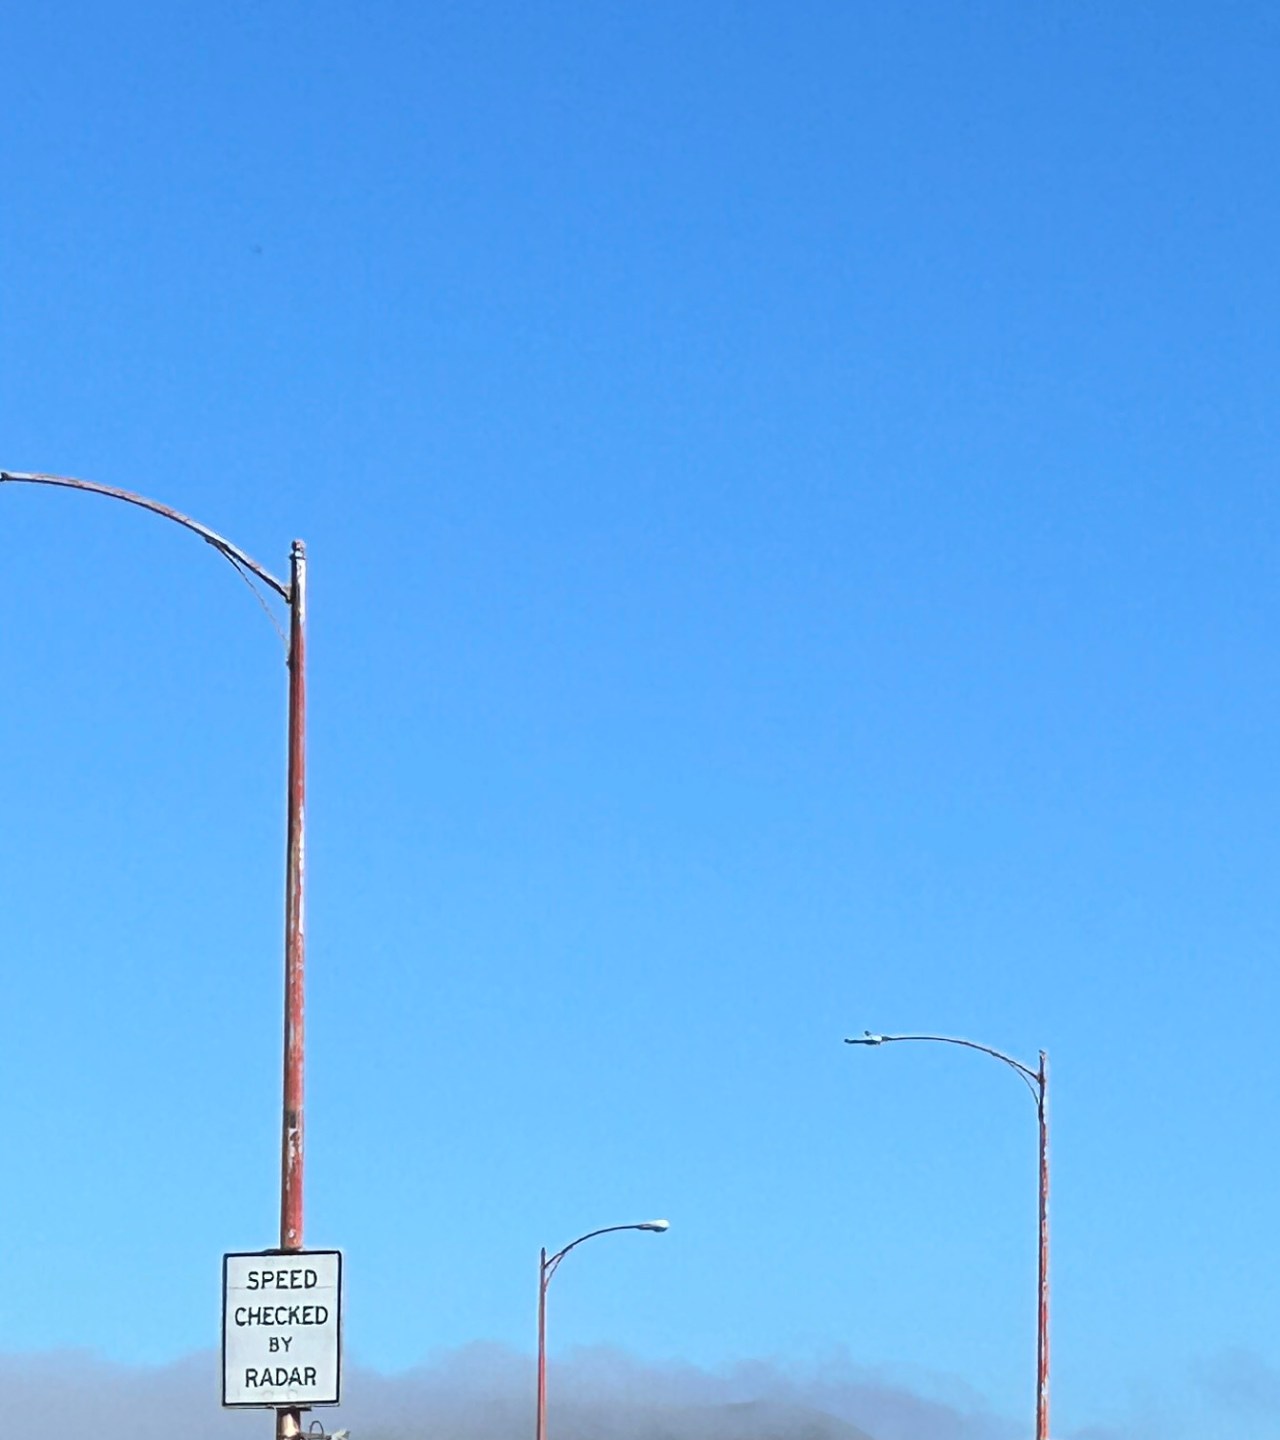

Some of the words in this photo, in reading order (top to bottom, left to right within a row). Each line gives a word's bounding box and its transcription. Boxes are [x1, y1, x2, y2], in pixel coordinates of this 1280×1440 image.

[246, 1269, 318, 1290] SPEED
[234, 1305, 329, 1327] CHECKED
[268, 1336, 293, 1353] BY
[245, 1367, 317, 1388] RADAR
